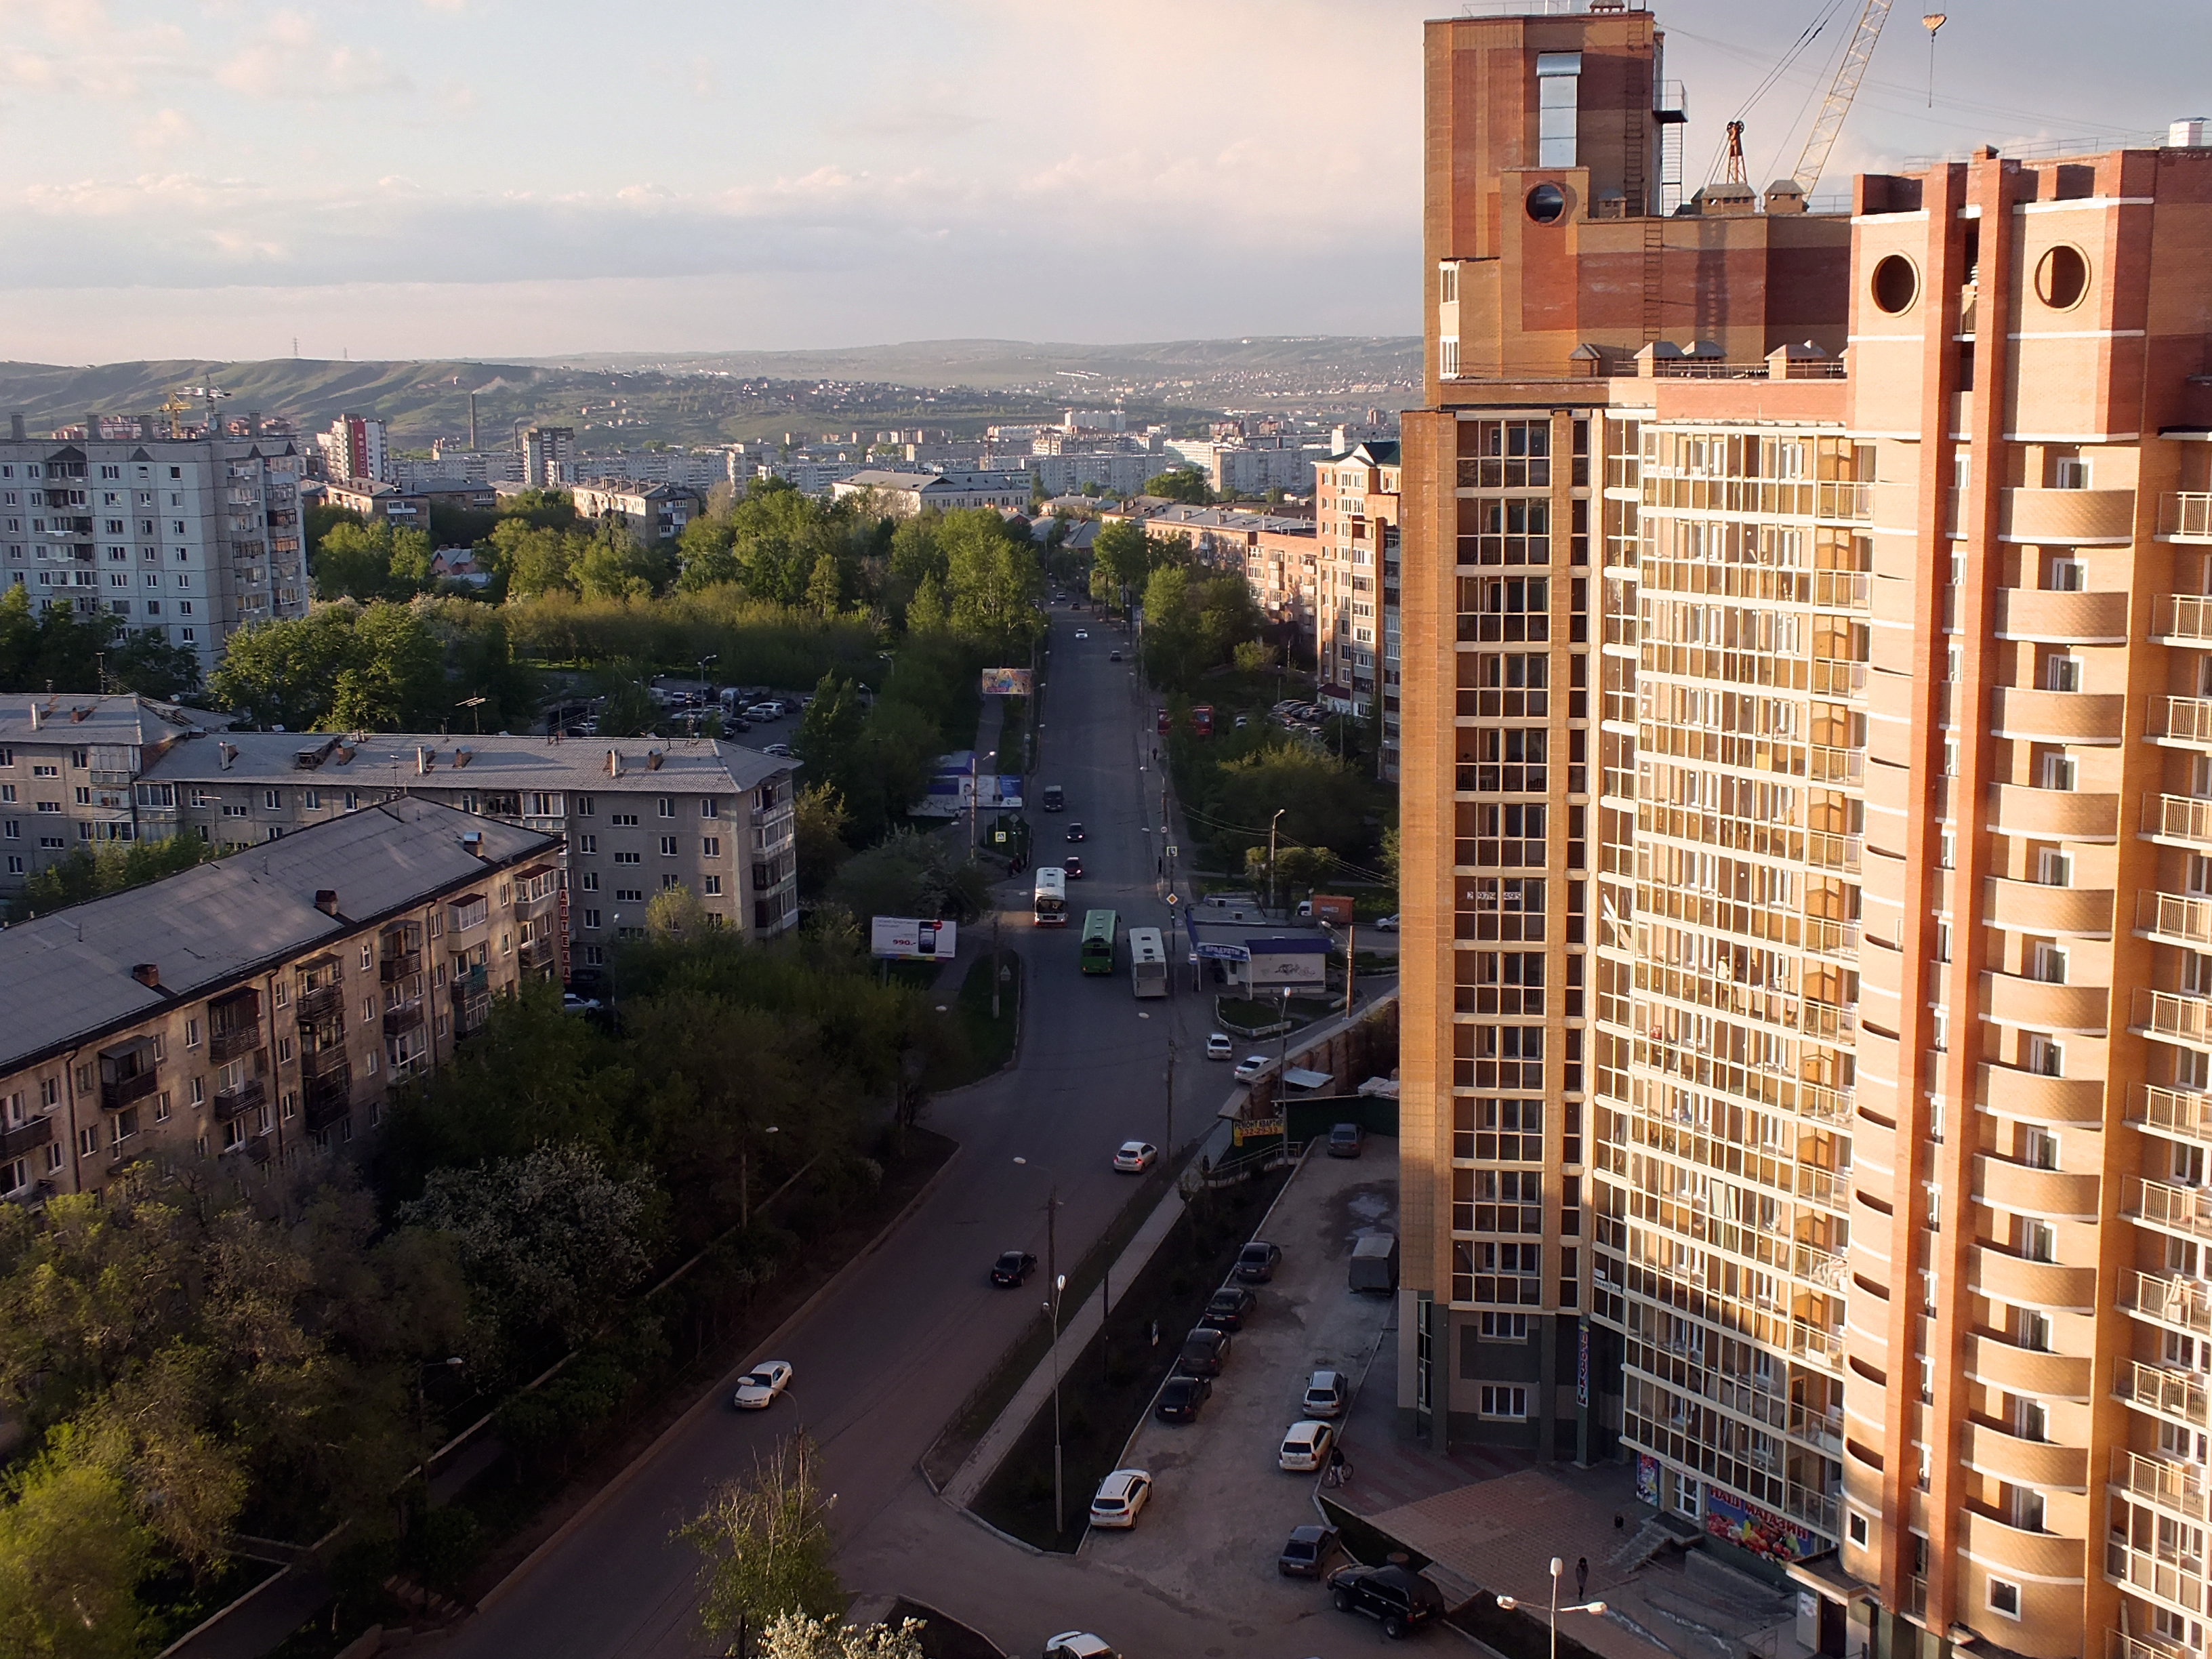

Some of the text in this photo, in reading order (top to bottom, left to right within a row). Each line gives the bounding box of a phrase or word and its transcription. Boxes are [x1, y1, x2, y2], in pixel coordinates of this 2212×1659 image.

[560, 890, 571, 977] АПТЕКА
[1235, 1120, 1258, 1130] РЕМОНТ
[1578, 1333, 1588, 1406] ПРОДУКТЫ
[1710, 1486, 1809, 1541] НАШ МАГАЗИН
